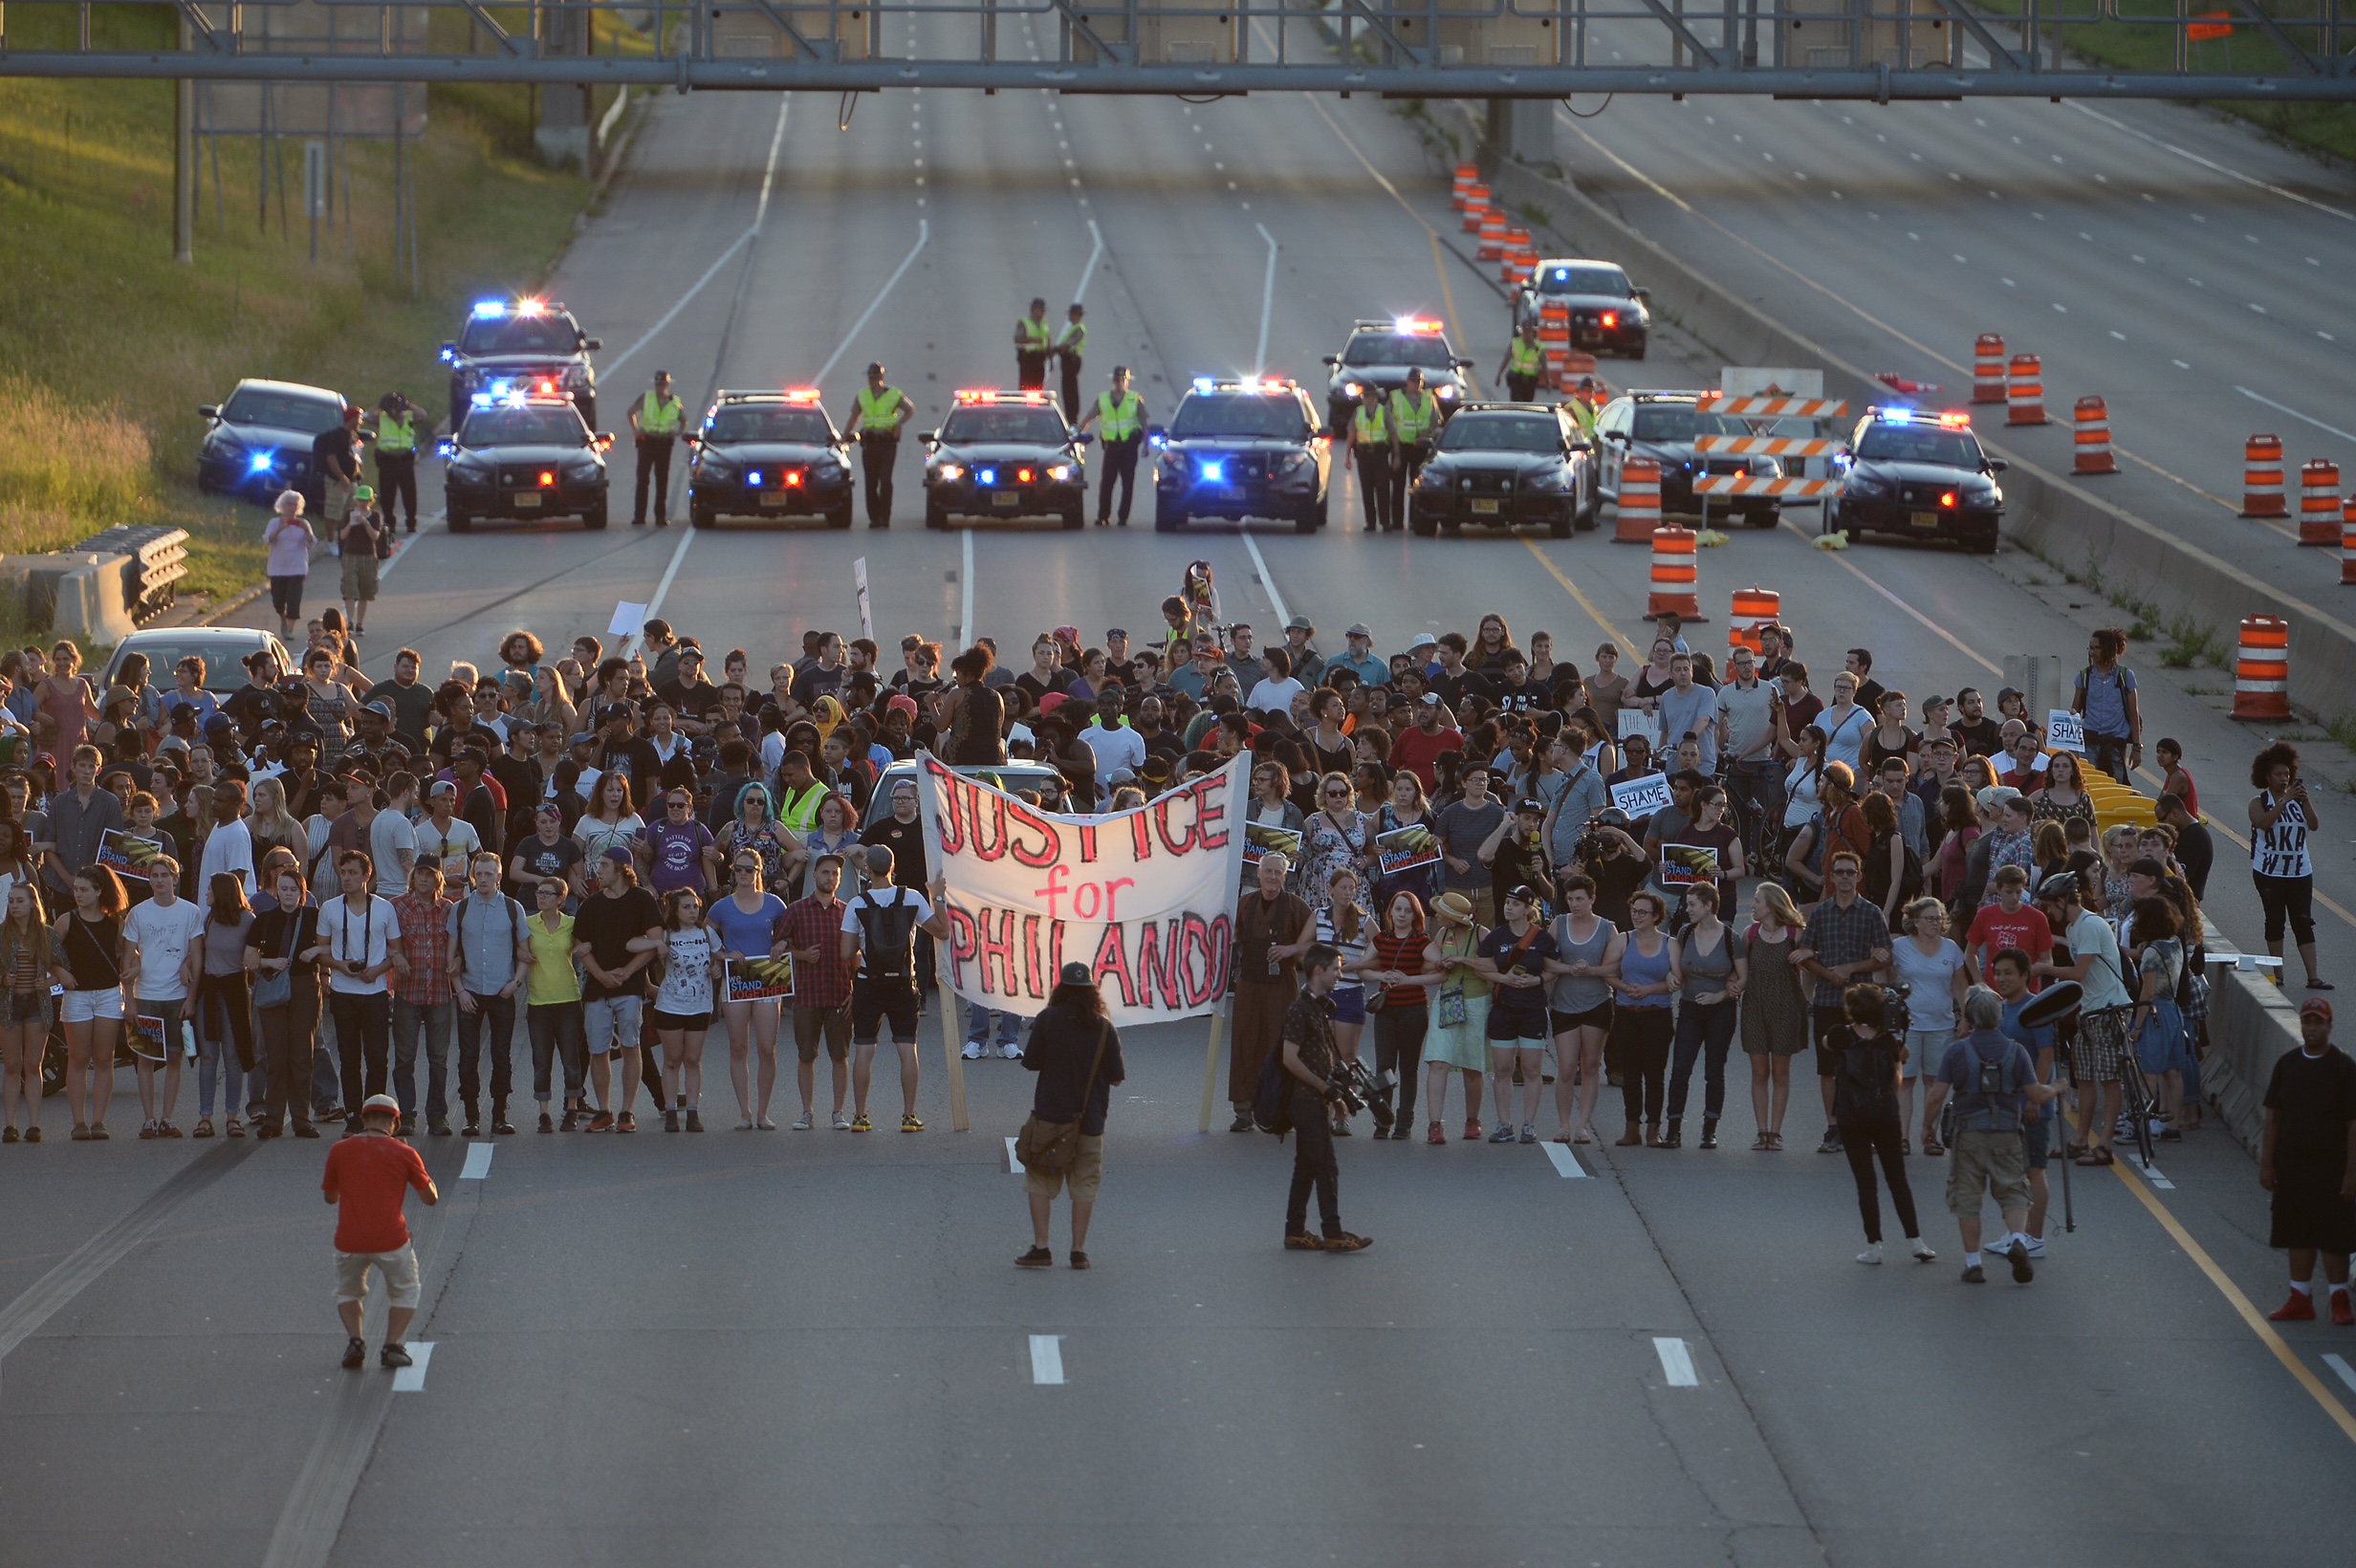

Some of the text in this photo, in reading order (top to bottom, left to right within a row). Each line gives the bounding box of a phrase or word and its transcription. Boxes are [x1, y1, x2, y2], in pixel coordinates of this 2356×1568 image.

[1619, 786, 1667, 810] SHAME
[2264, 825, 2306, 852] AKA
[100, 850, 128, 864] STAND
[1384, 849, 1411, 864] STAND
[1385, 851, 1436, 872] TOGETHER
[2261, 852, 2304, 876] WTF
[1666, 865, 1692, 875] STAND
[1666, 873, 1712, 882] TOGETHER
[1035, 863, 1136, 923] for
[947, 904, 1232, 1011] PHILANDO
[730, 985, 789, 1000] TOGETHER
[731, 980, 762, 991] STAND
